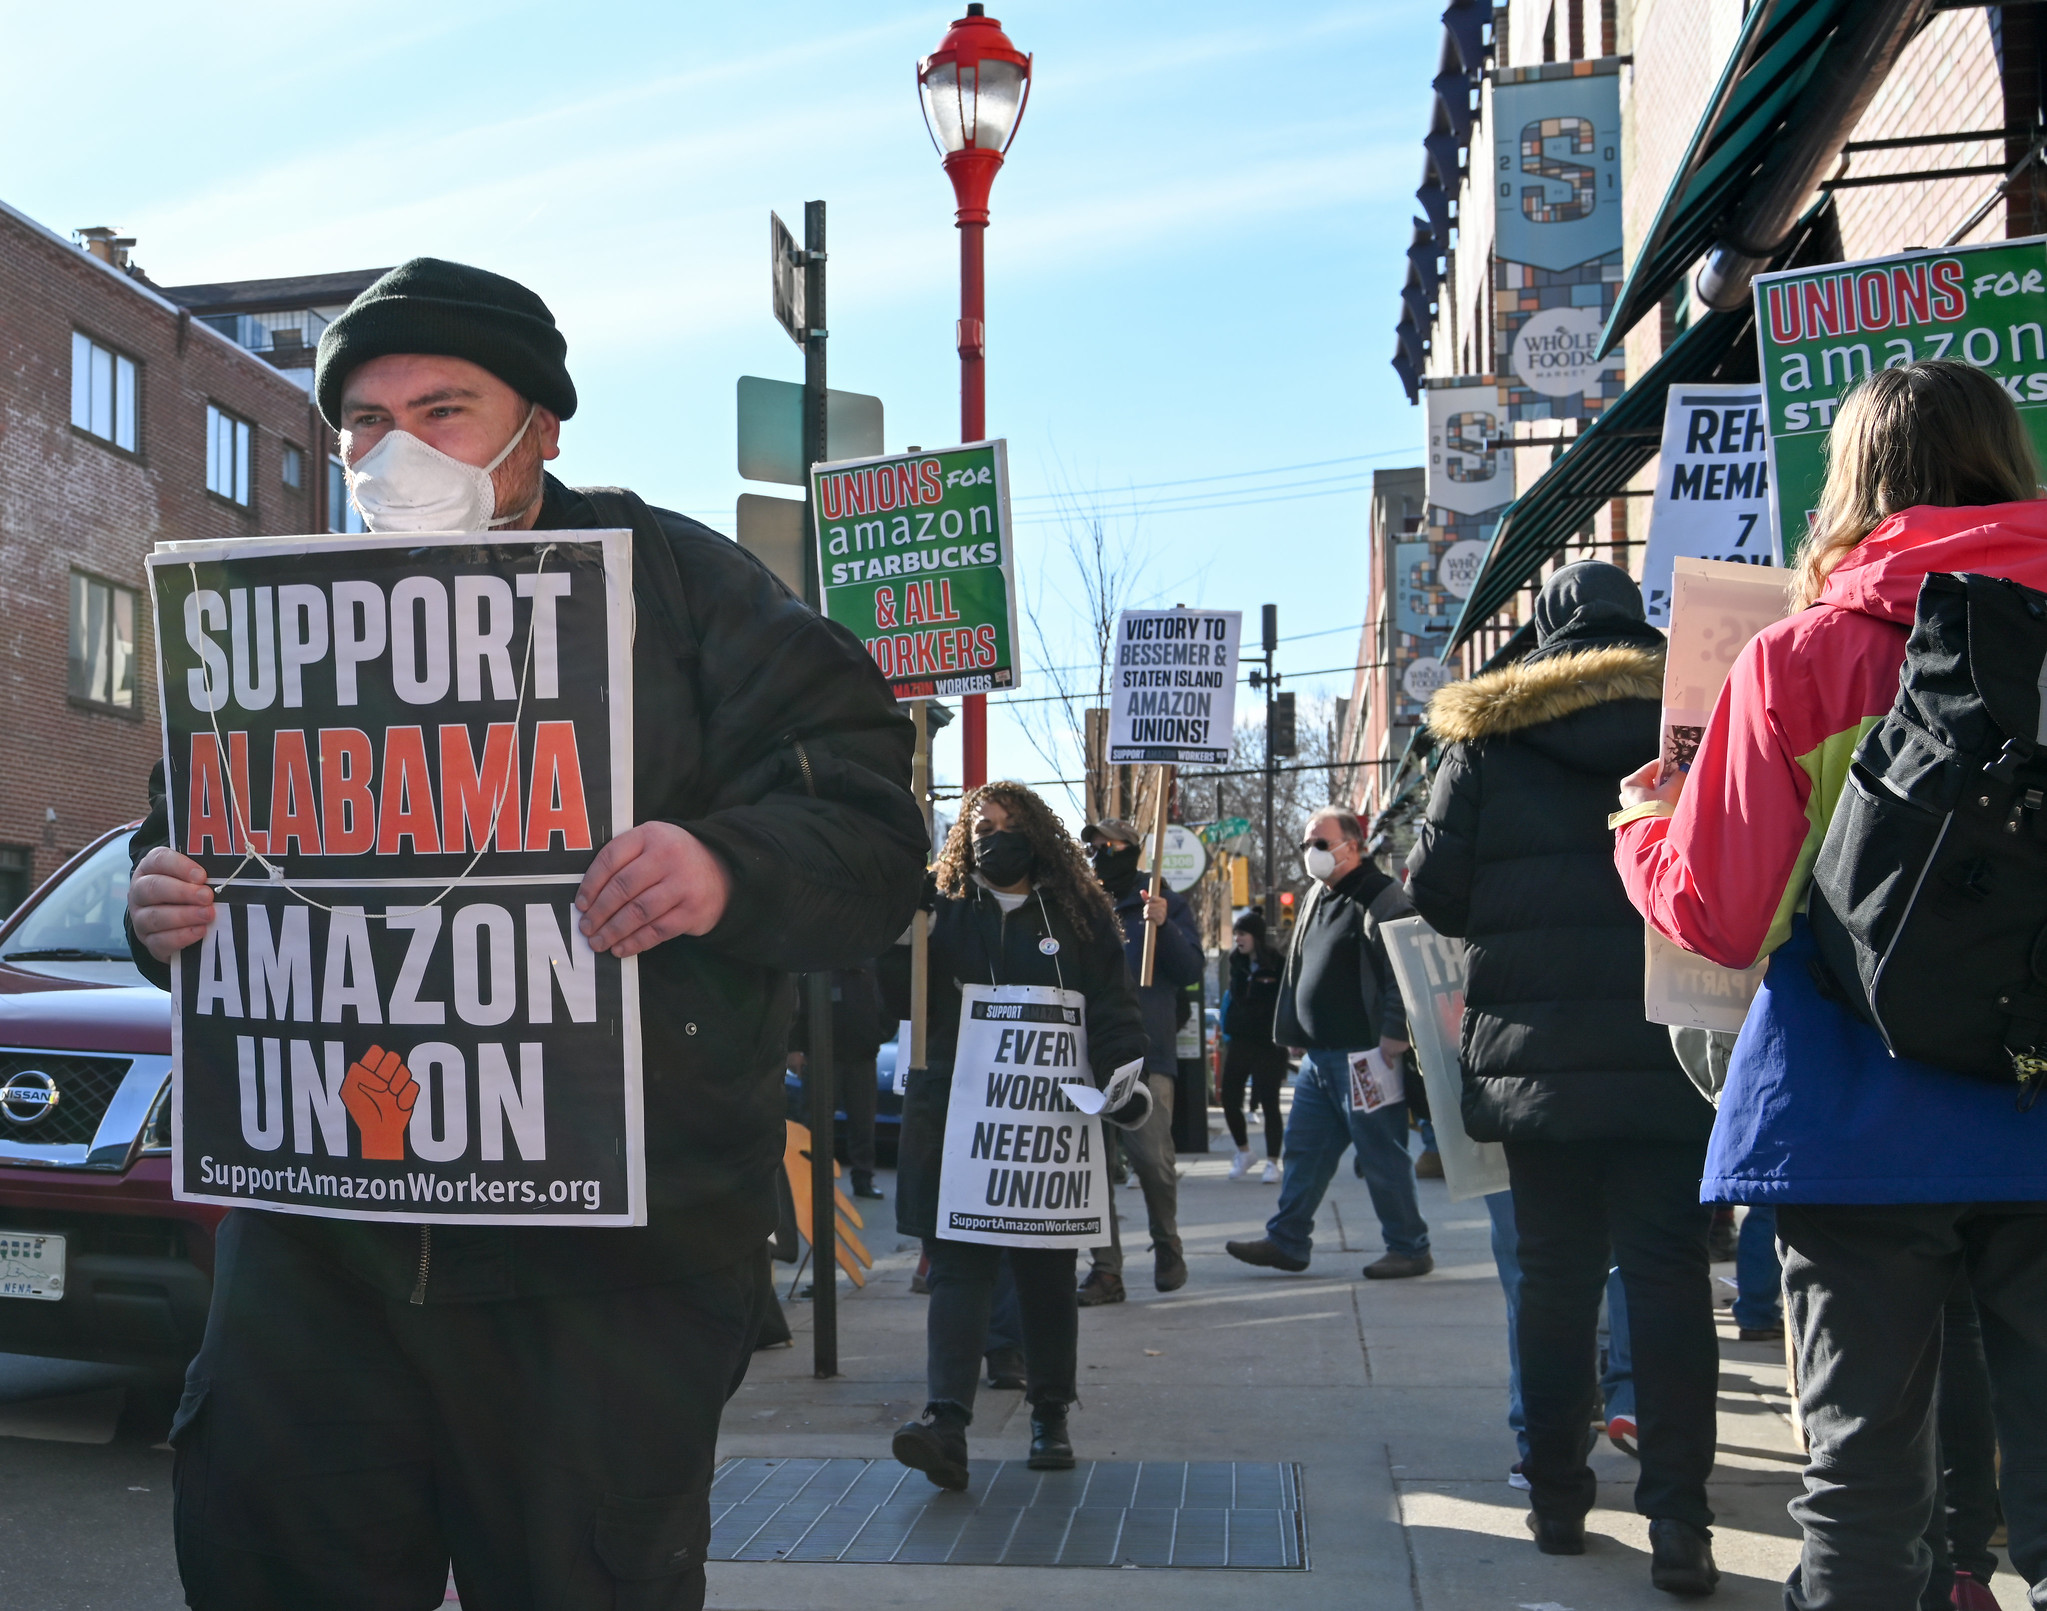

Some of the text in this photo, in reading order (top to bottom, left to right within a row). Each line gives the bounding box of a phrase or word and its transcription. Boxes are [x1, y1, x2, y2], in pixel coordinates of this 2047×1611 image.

[1767, 258, 2046, 346] UNIONS FOR
[1523, 332, 1598, 351] WHOLE
[1779, 321, 2047, 392] amazon
[1528, 350, 1597, 369] FOODS
[819, 458, 993, 520] UNIONS FOR
[828, 505, 992, 556] amazon
[1734, 513, 1758, 548] 7
[831, 542, 997, 585] STARBUCKS
[875, 578, 960, 630] & ALL
[184, 572, 571, 712] SUPPORT
[1126, 617, 1226, 641] VICTORY TO
[1120, 643, 1227, 667] BESSEMER &
[935, 674, 992, 696] WORKERS
[1123, 670, 1223, 689] STATEN ISLAND
[1127, 691, 1211, 717] AMAZON
[1131, 718, 1210, 744] UNIONS!
[1112, 749, 1145, 760] SUPPORT
[1177, 750, 1215, 762] WORKERS
[187, 720, 593, 856] ALABAMA
[196, 902, 597, 1026] AMAZON
[986, 1004, 1022, 1020] SUPPORT
[2, 1090, 51, 1101] NISSAN
[970, 1121, 1090, 1164] NEEDS A
[200, 1156, 601, 1209] SupportAmazonWorkers.org
[985, 1168, 1091, 1210] UNION!
[951, 1213, 1100, 1234] SupportAmazonWorkers.org
[4, 1282, 32, 1294] NENA
